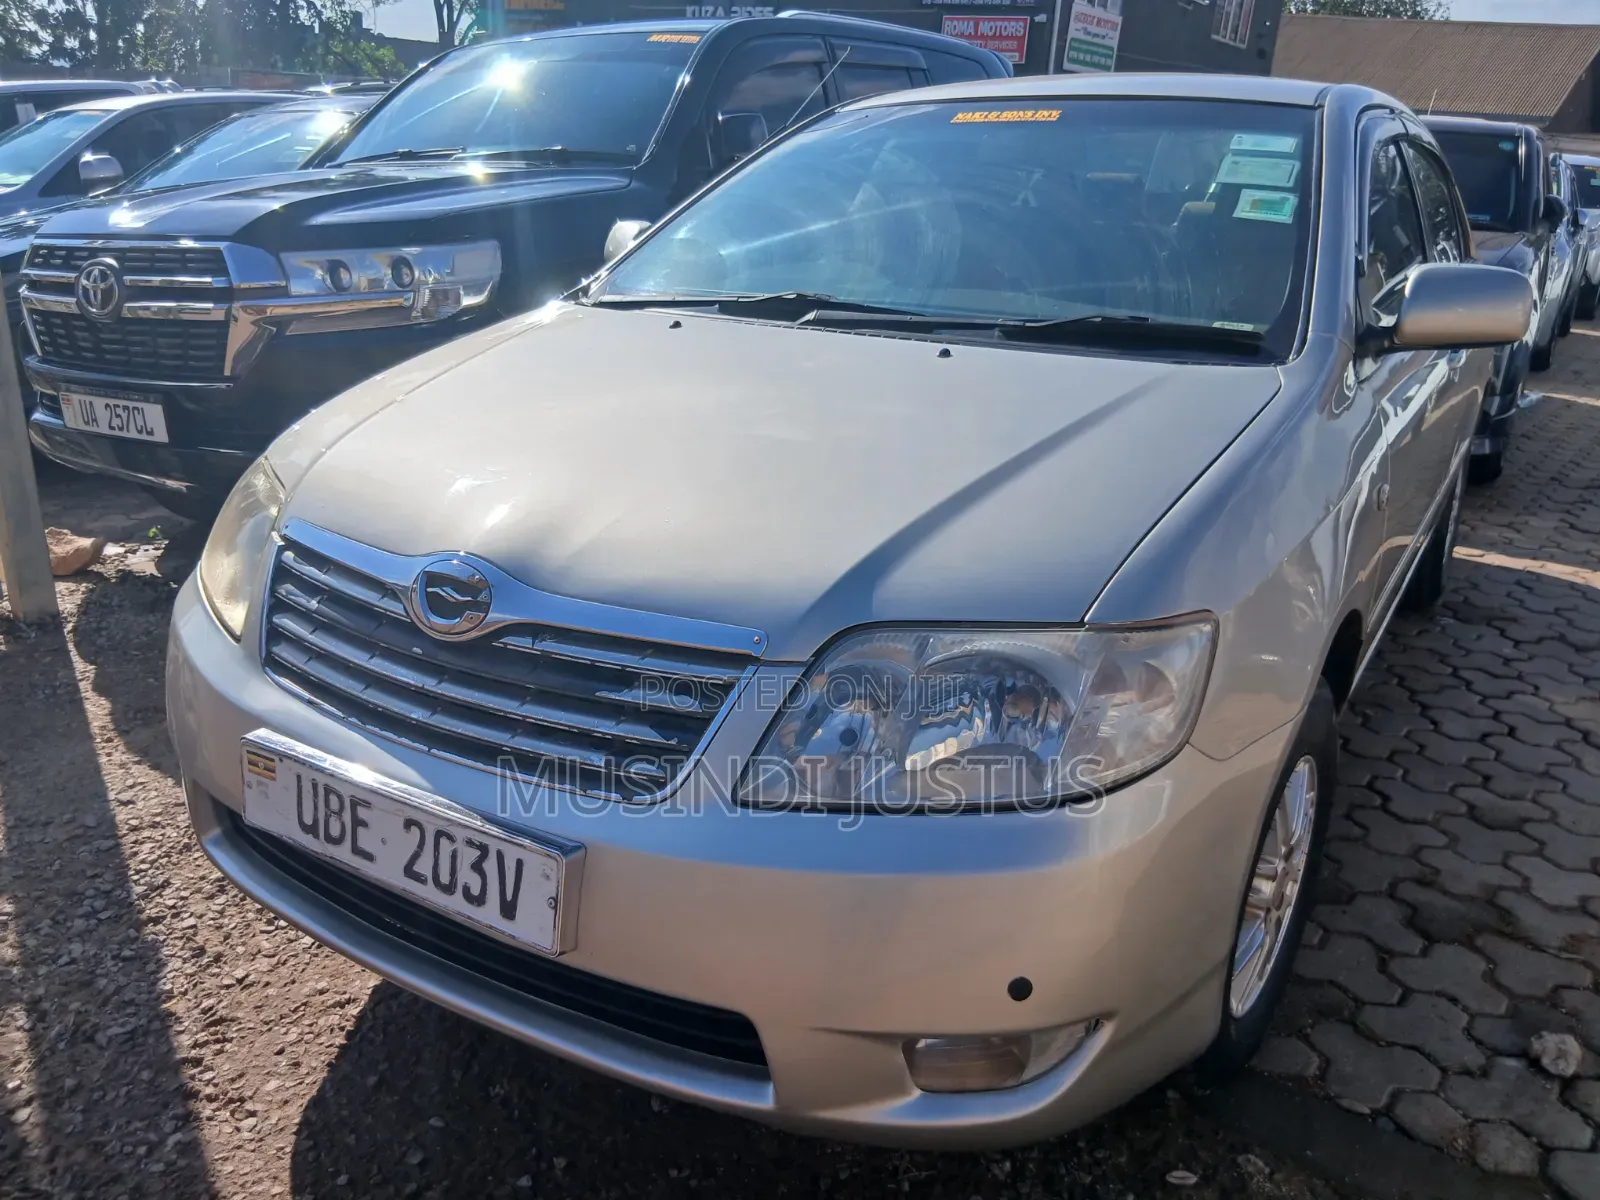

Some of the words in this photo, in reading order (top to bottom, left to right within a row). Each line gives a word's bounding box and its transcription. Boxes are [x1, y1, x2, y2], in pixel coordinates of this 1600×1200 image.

[944, 20, 975, 36] ROMA
[978, 21, 1025, 37] MOTORS
[986, 40, 1018, 50] SERVICES
[1000, 110, 1036, 119] SONS
[78, 398, 100, 428] UA
[104, 402, 155, 437] 257CL
[296, 771, 376, 864] UBE
[402, 817, 525, 922] 203V
